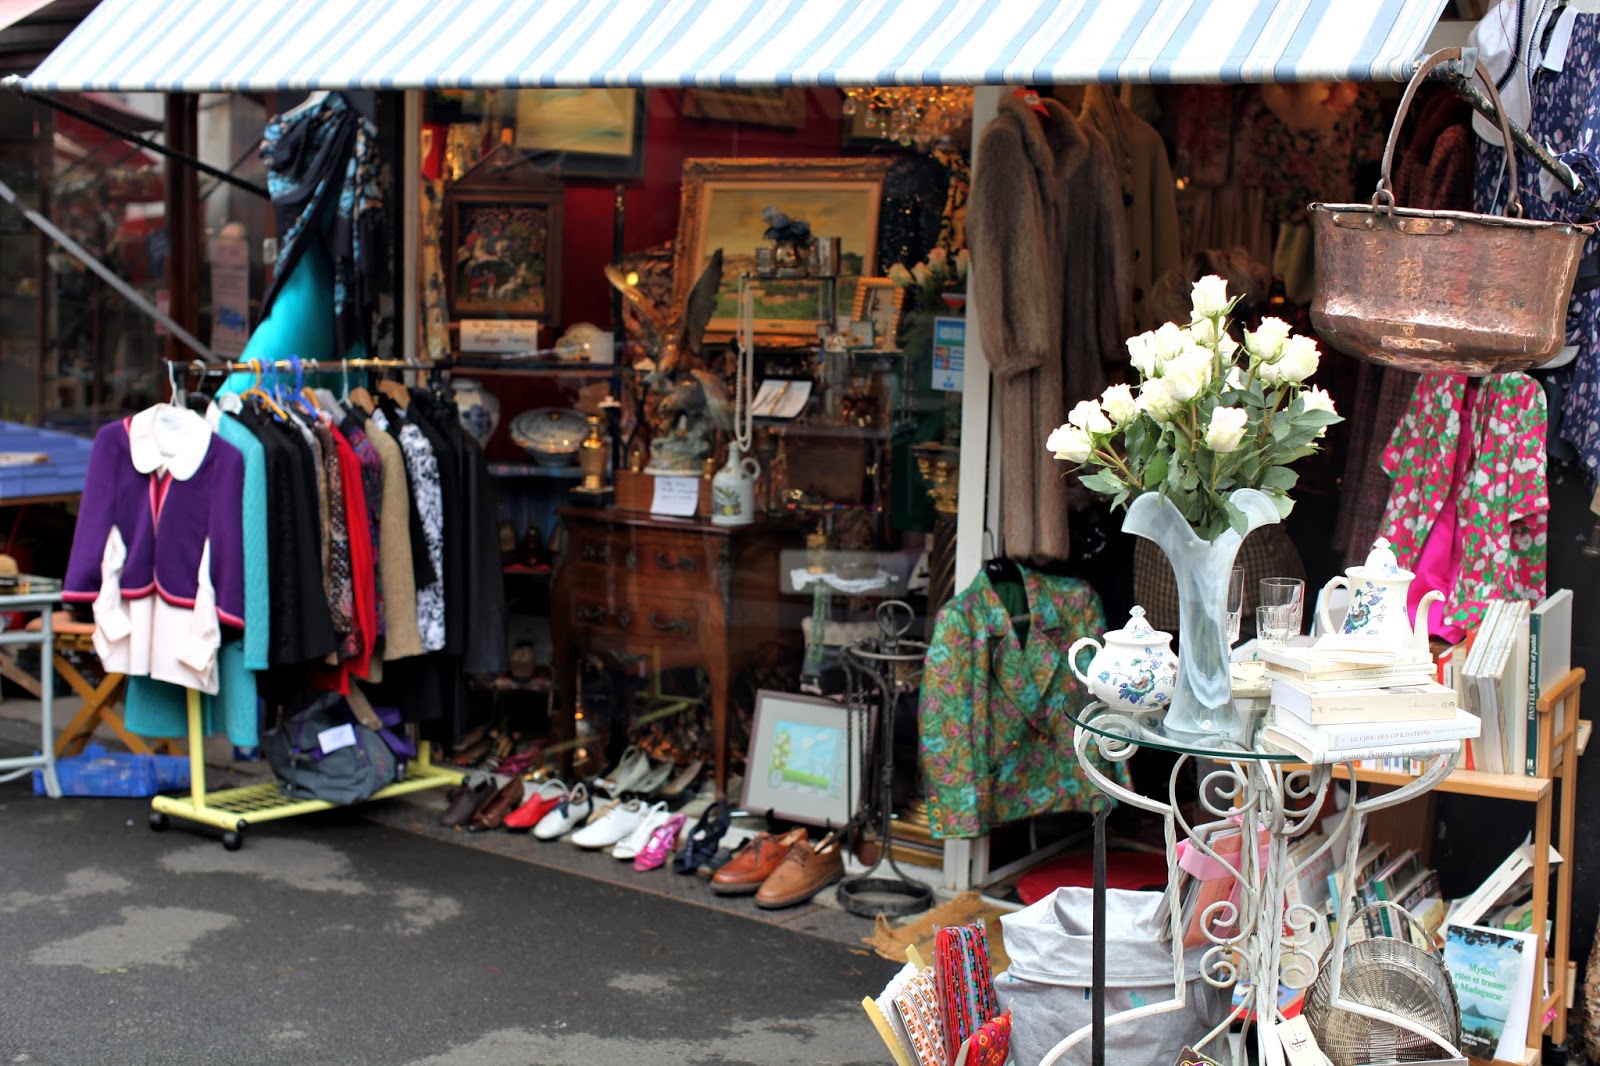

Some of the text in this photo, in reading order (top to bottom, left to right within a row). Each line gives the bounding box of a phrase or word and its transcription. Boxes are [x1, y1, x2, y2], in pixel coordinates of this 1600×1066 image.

[1528, 683, 1536, 720] PASTEUR
[1390, 730, 1431, 738] CIVILISATIONS
[1340, 750, 1393, 761] Jeanne Bourin
[1410, 748, 1426, 756] dame
[1454, 972, 1472, 982] rites
[1482, 978, 1506, 991] transes
[1460, 983, 1503, 1002] Madagascar
